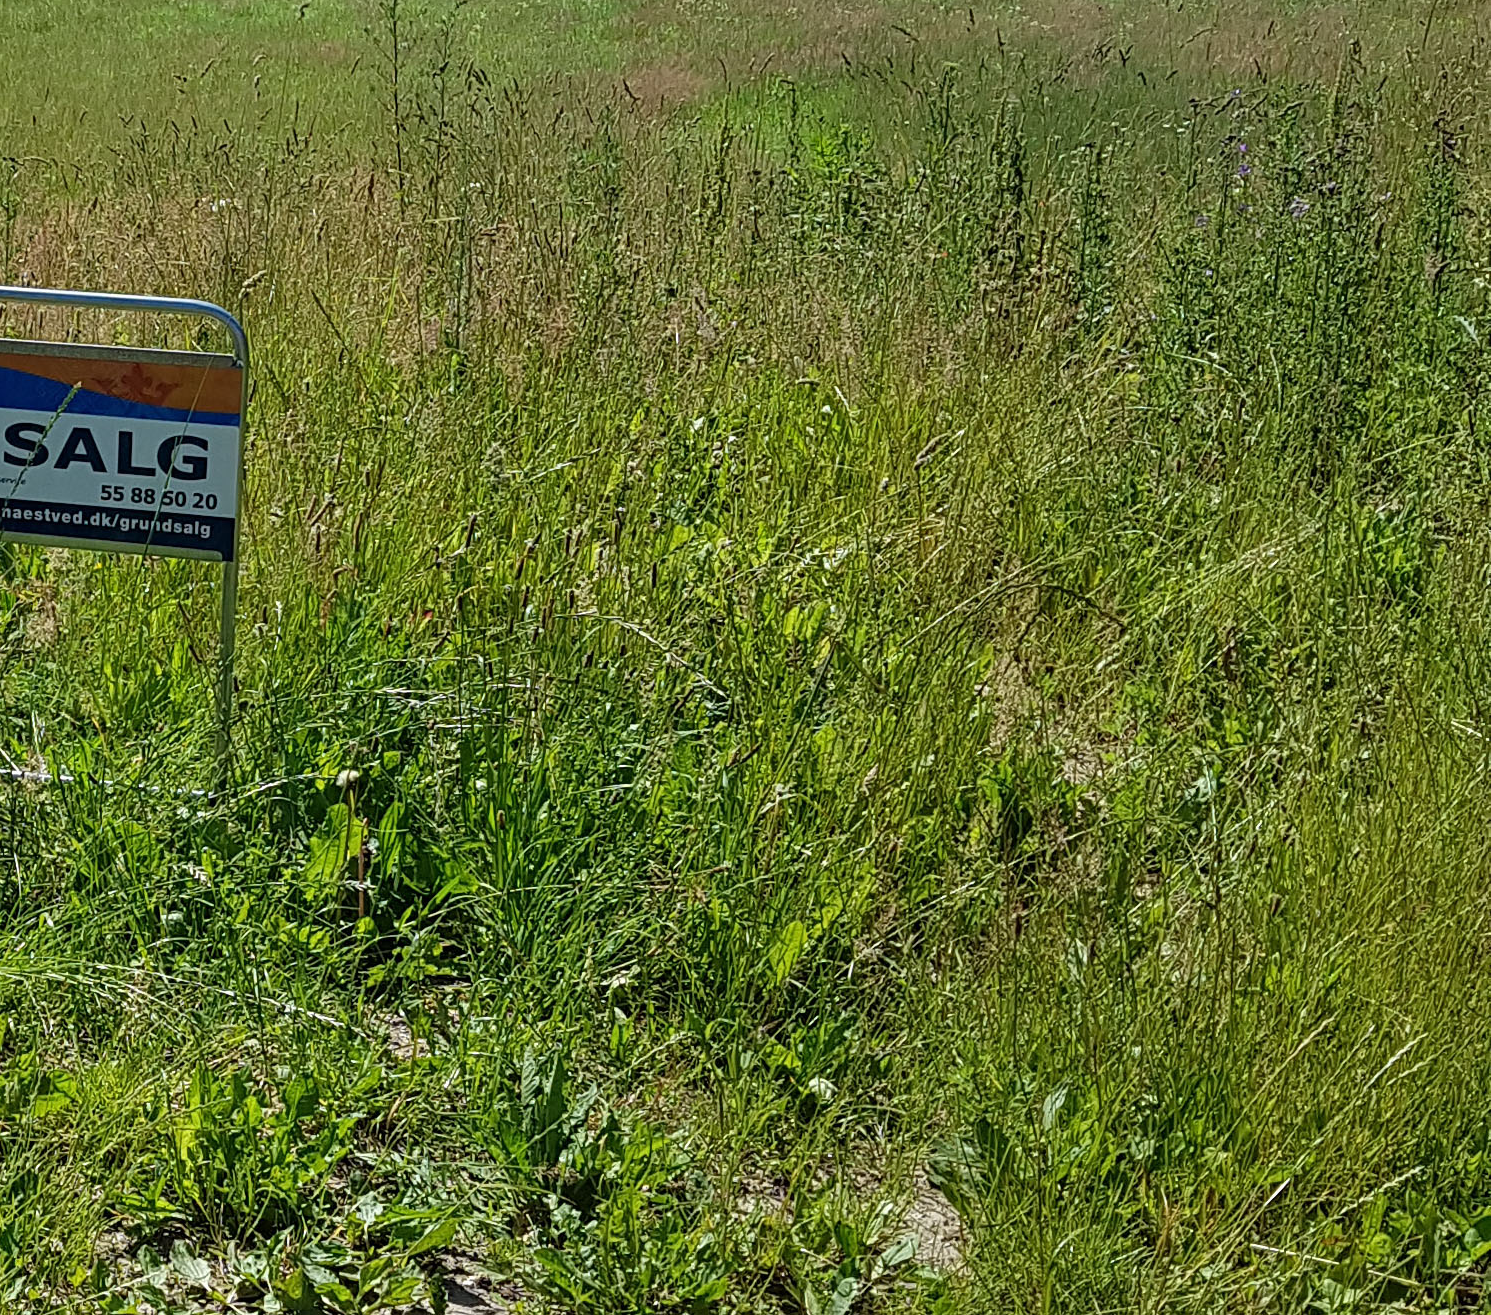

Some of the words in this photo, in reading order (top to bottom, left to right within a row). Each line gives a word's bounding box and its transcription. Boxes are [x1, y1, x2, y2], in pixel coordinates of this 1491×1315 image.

[3, 422, 210, 480] SALG
[100, 484, 124, 502] 55
[130, 488, 156, 505] 88
[161, 490, 187, 507] 50
[192, 492, 218, 510] 20
